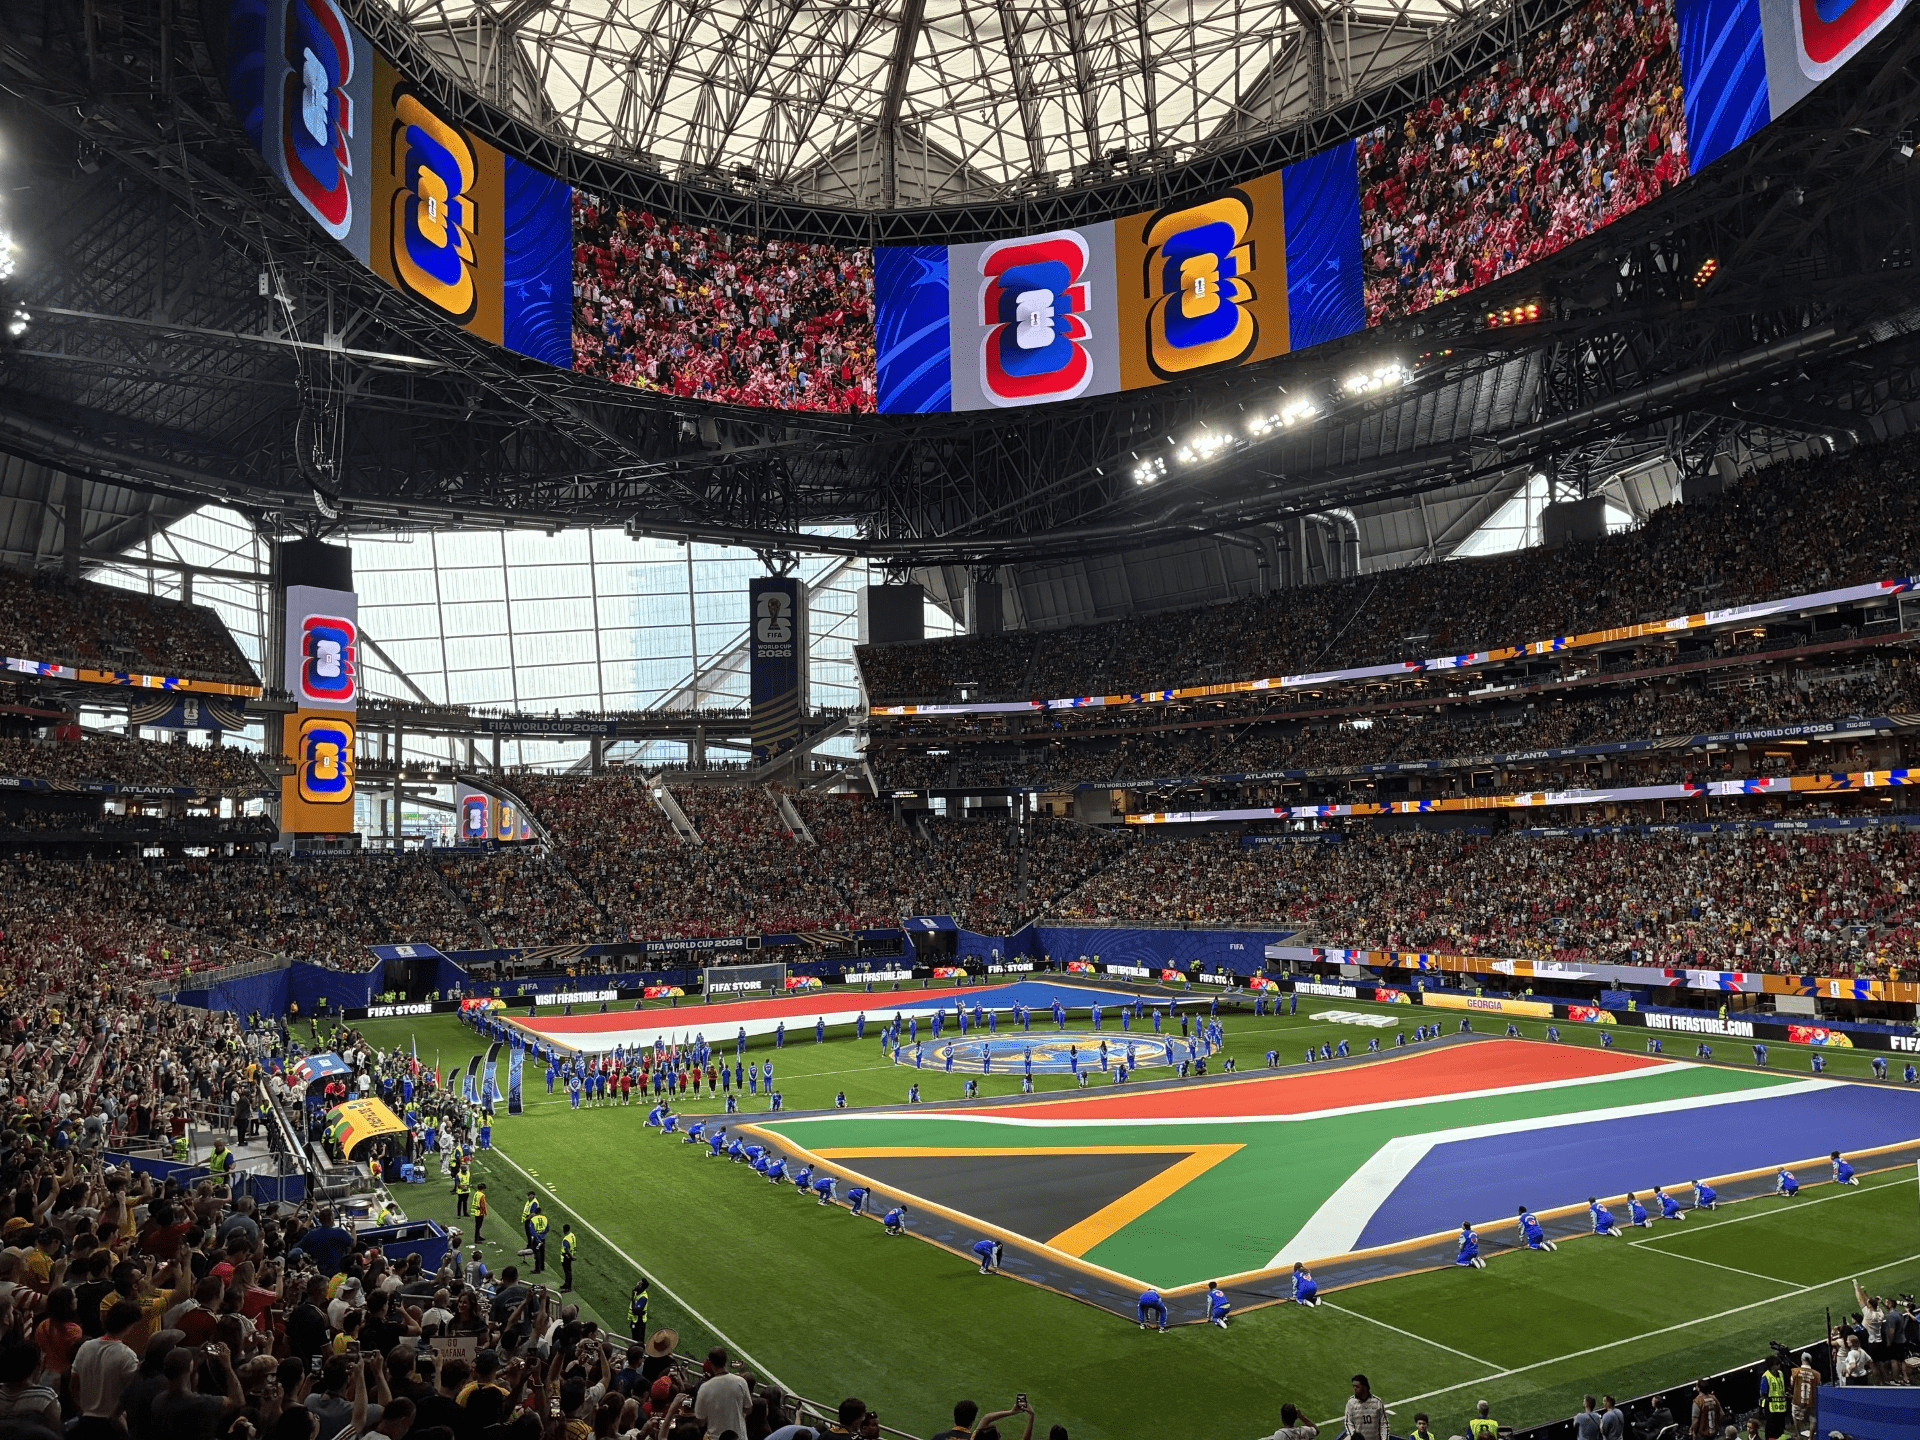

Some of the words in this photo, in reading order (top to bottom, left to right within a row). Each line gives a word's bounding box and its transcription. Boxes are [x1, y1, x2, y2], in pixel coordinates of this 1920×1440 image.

[489, 722, 511, 730] FIFA
[512, 722, 549, 731] WORLD
[551, 723, 571, 731] CUP
[573, 724, 607, 732] 2026
[1734, 731, 1752, 740] FIFA
[1753, 728, 1783, 739] WORLD
[1784, 727, 1801, 736] CUP
[1802, 723, 1834, 733] 2026
[1244, 771, 1285, 780] ATLANTA
[121, 785, 175, 794] ATLANTA
[647, 943, 665, 951] FIFA
[666, 941, 696, 950] WORLD
[697, 940, 714, 948] CUP
[714, 938, 743, 947] 2026
[1007, 963, 1033, 973] STORE
[845, 973, 862, 984] VISIT
[863, 970, 912, 982] FIFASTORE.COM
[1199, 973, 1213, 983] FIFA
[1213, 975, 1234, 986] STO
[710, 983, 731, 992] FIFA
[732, 981, 761, 991] STORE
[1294, 982, 1310, 994] VISIT
[1310, 984, 1357, 998] FIFASTORE.COM
[535, 994, 556, 1005] VISIT
[557, 990, 617, 1004] FIFASTORE.COM
[367, 1006, 393, 1018] FIFA
[396, 1003, 432, 1015] STORE
[1467, 999, 1502, 1010] GEORGIA
[1645, 1013, 1671, 1029] VISIT
[1672, 1015, 1753, 1038] FIFASTORE.COM
[448, 1339, 457, 1347] GO
[1362, 1415, 1372, 1424] 10
